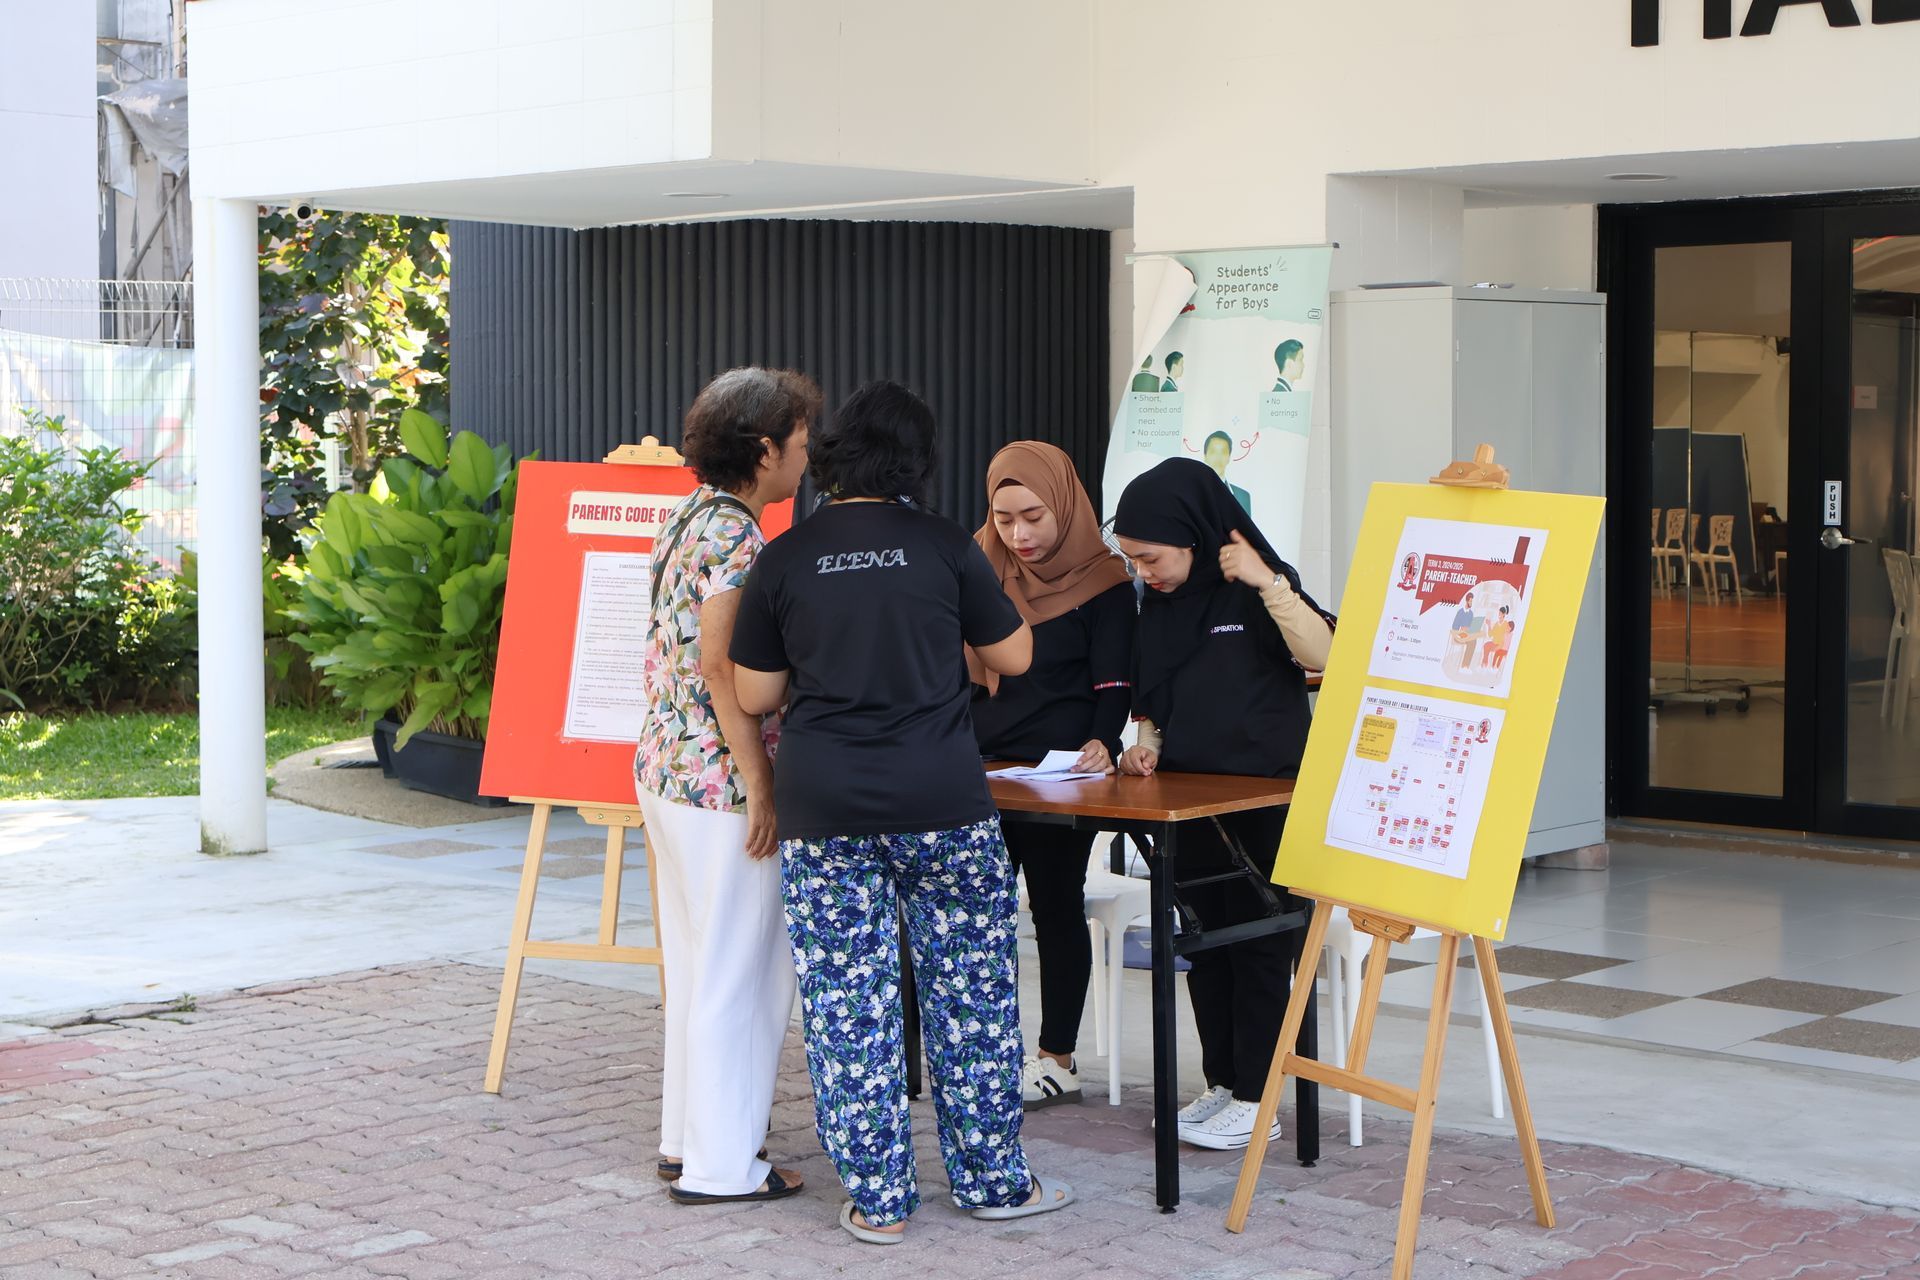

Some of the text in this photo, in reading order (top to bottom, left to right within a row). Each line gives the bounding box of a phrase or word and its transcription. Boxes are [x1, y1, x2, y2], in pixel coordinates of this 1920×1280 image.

[1217, 264, 1272, 278] Students'
[1207, 282, 1279, 295] Appearance
[1216, 297, 1269, 311] for Boys
[1138, 394, 1162, 403] Short,
[1271, 397, 1281, 405] No
[1138, 406, 1182, 414] combed and
[1270, 410, 1298, 419] earrings
[1137, 429, 1180, 437] No coloured
[1137, 440, 1153, 448] hair
[572, 503, 622, 521] PARENTS
[625, 506, 655, 523] CODE
[816, 548, 908, 574] ELENA
[1424, 569, 1478, 586] PARENT-TEACHER
[1421, 581, 1435, 593] DAY
